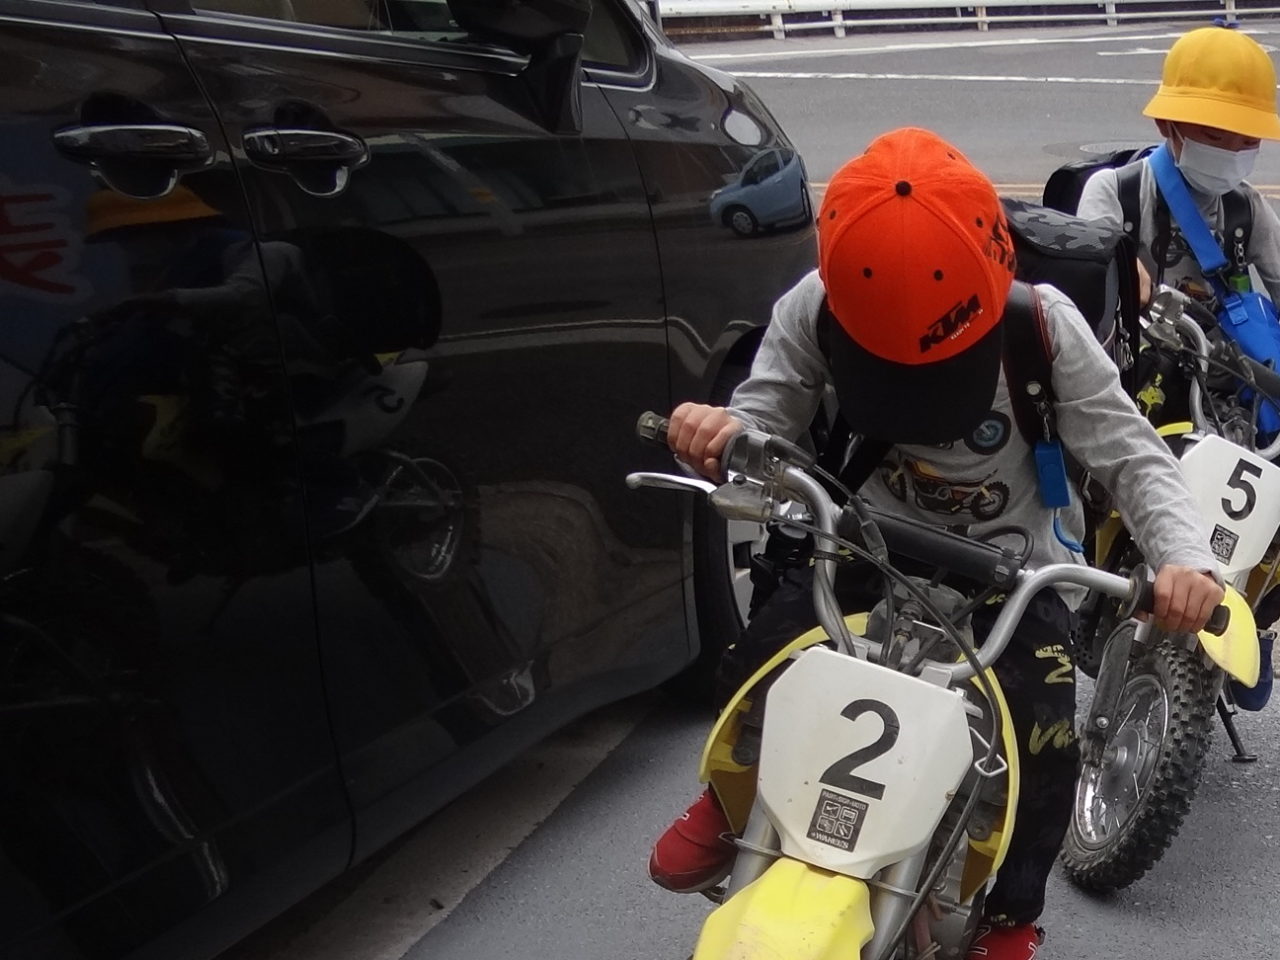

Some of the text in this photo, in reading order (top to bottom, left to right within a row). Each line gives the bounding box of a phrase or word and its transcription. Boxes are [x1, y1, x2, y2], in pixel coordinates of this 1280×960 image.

[919, 293, 981, 354] KTM
[1221, 457, 1263, 522] 5
[818, 698, 901, 801] 2
